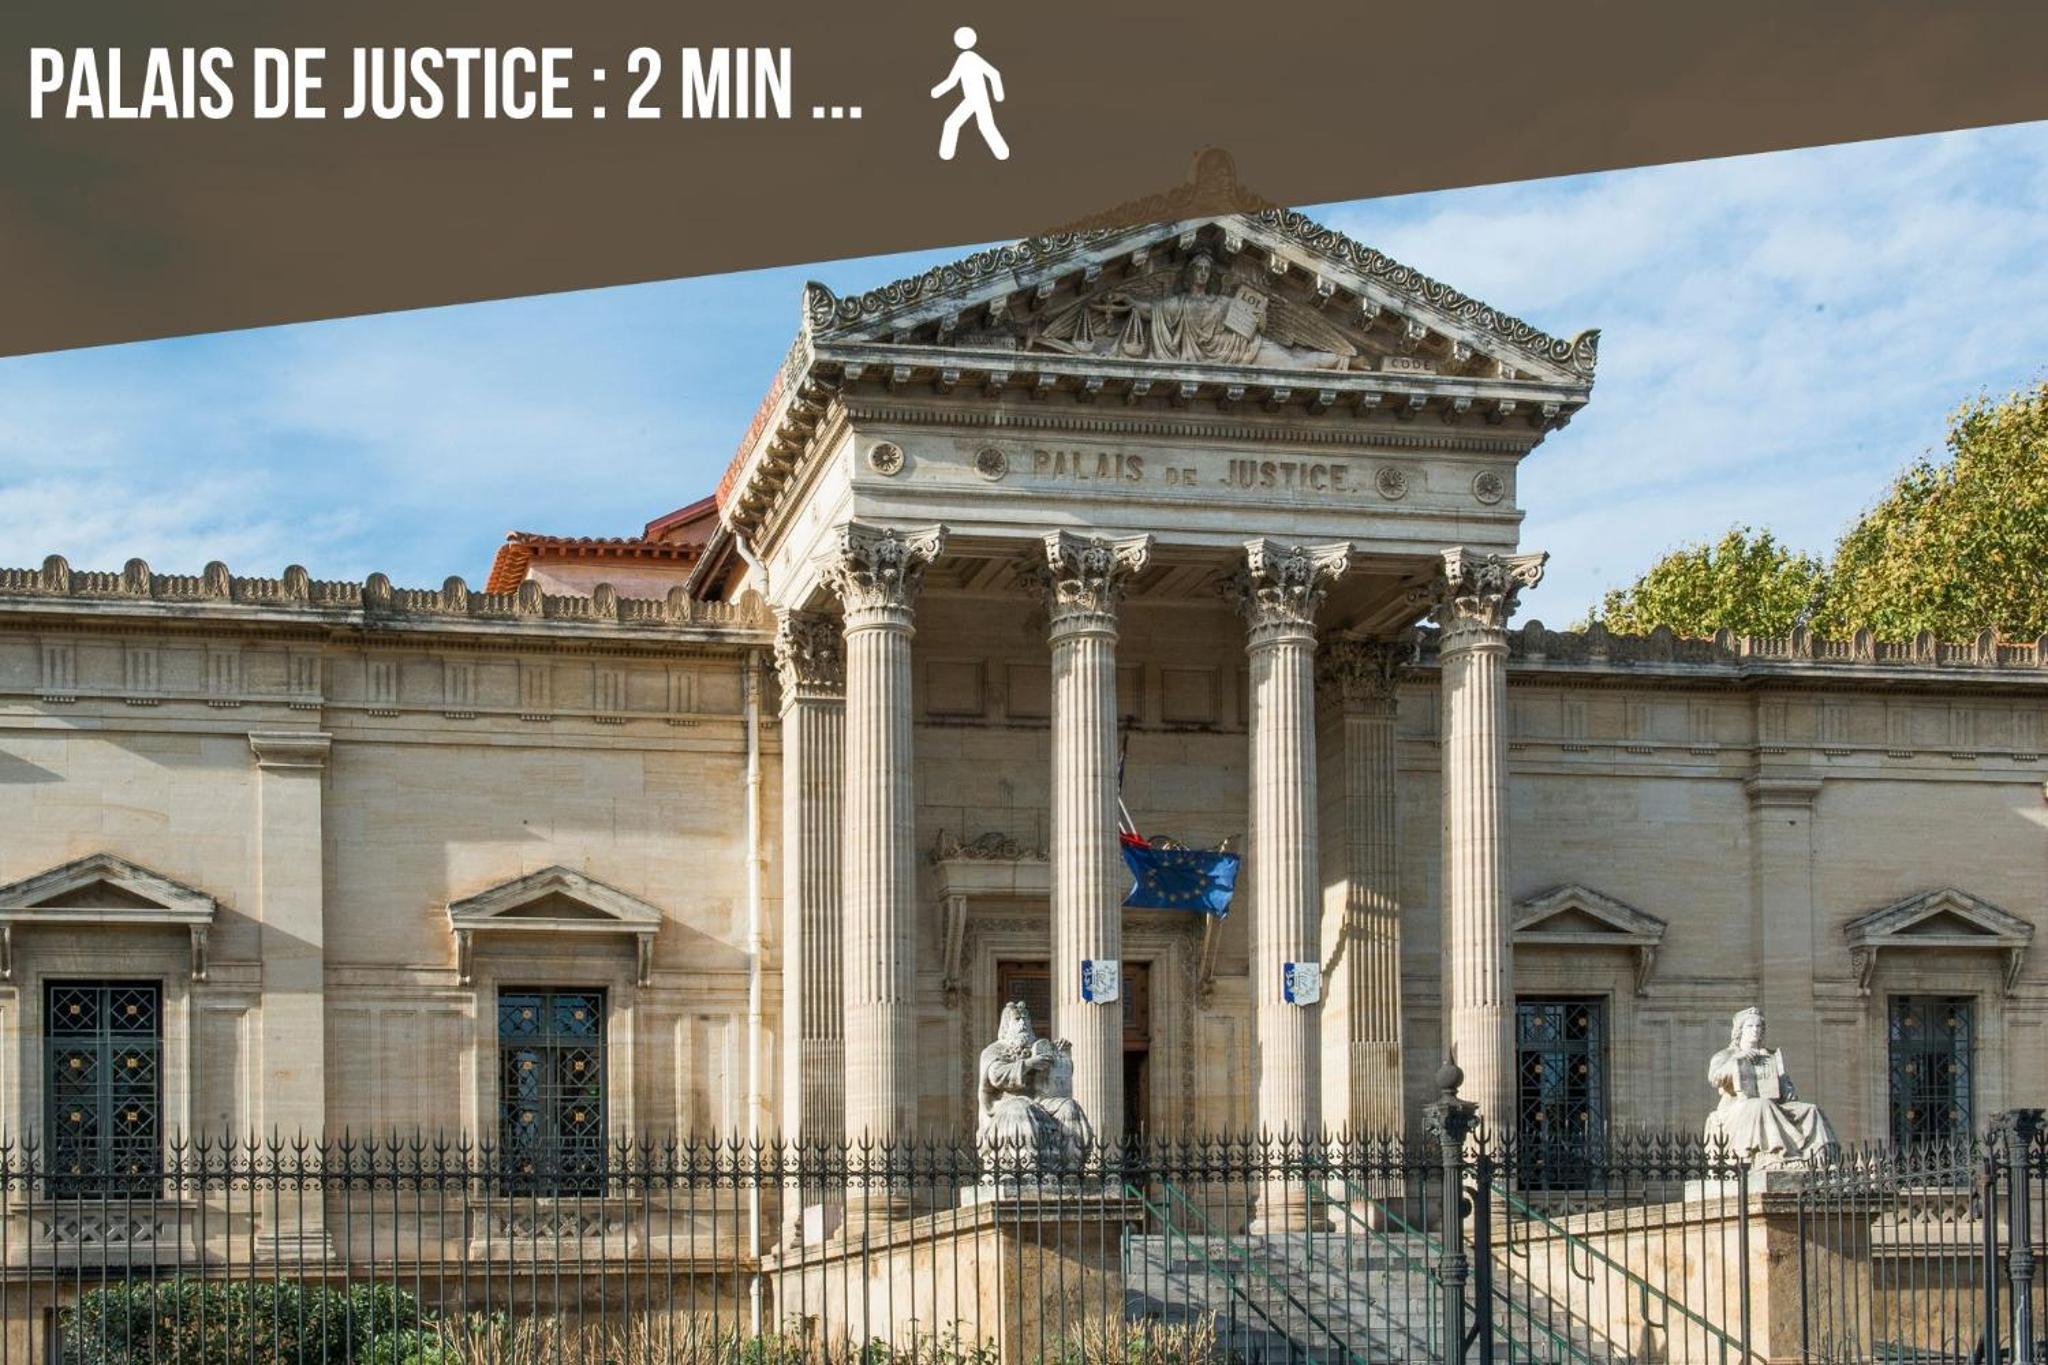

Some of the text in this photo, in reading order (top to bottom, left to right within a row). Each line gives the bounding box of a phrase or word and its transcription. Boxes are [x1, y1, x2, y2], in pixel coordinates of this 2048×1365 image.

[1391, 358, 1431, 371] CODE
[1033, 450, 1145, 482] PALAIS
[1165, 467, 1197, 486] DE
